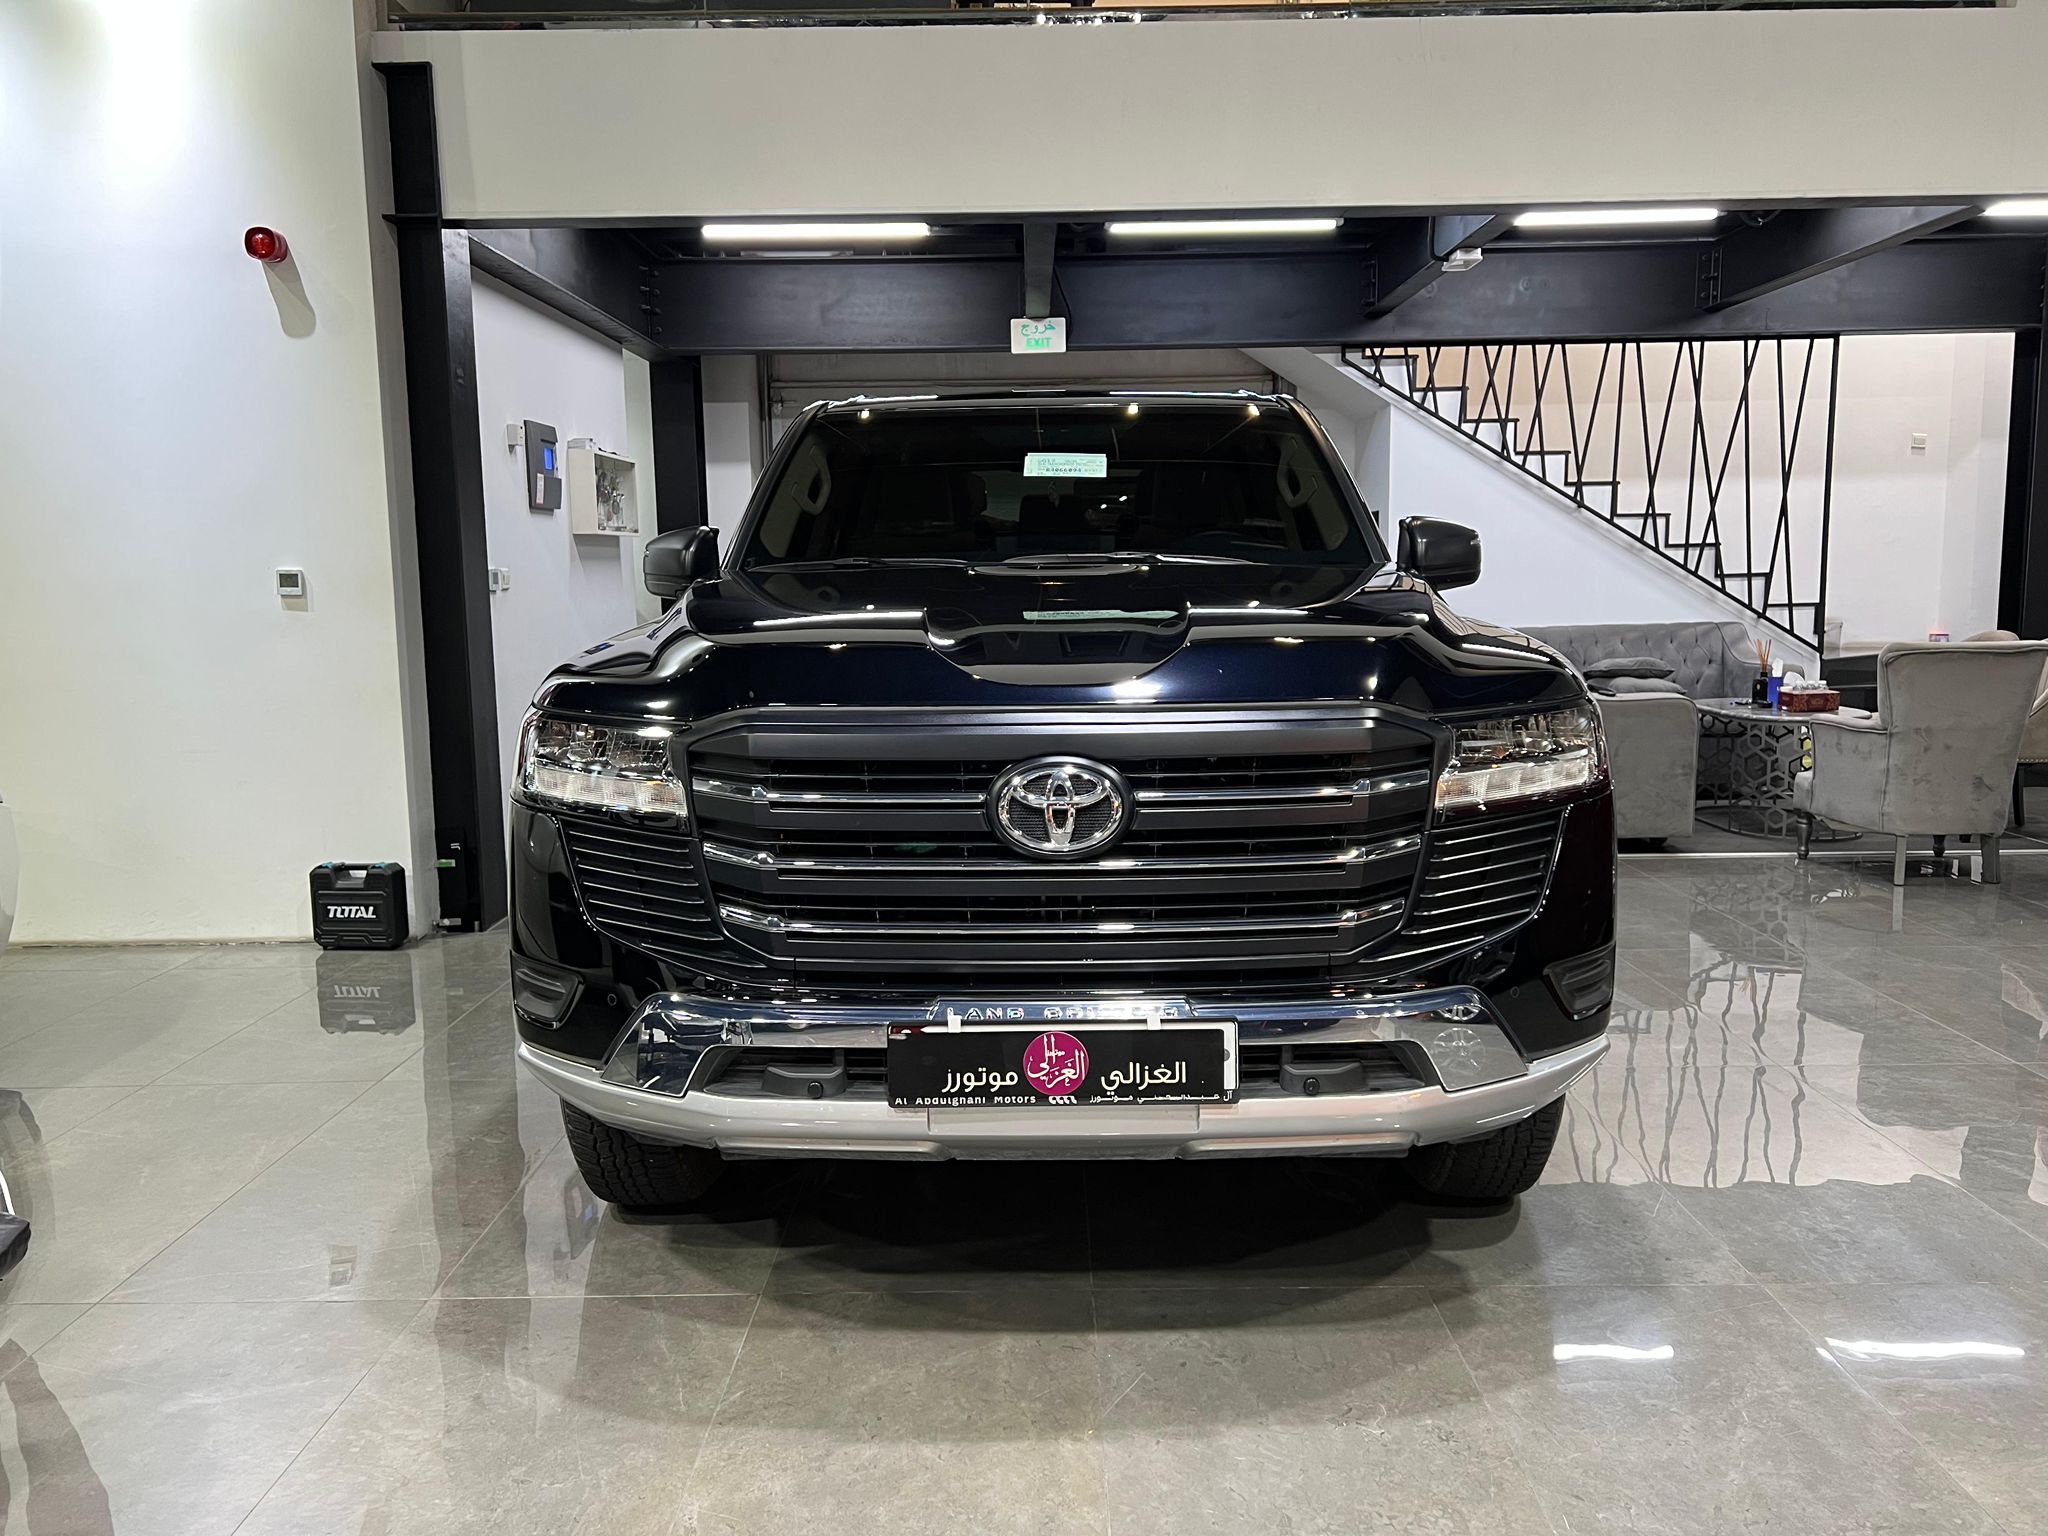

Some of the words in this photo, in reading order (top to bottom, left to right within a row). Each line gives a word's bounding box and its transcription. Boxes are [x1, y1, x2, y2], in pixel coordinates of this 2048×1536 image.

[1020, 320, 1056, 337] خروج
[1026, 337, 1052, 349] EXIT
[327, 906, 376, 918] TOTAL
[941, 1067, 1019, 1093] موتورز
[1100, 1061, 1187, 1095] الغزالي
